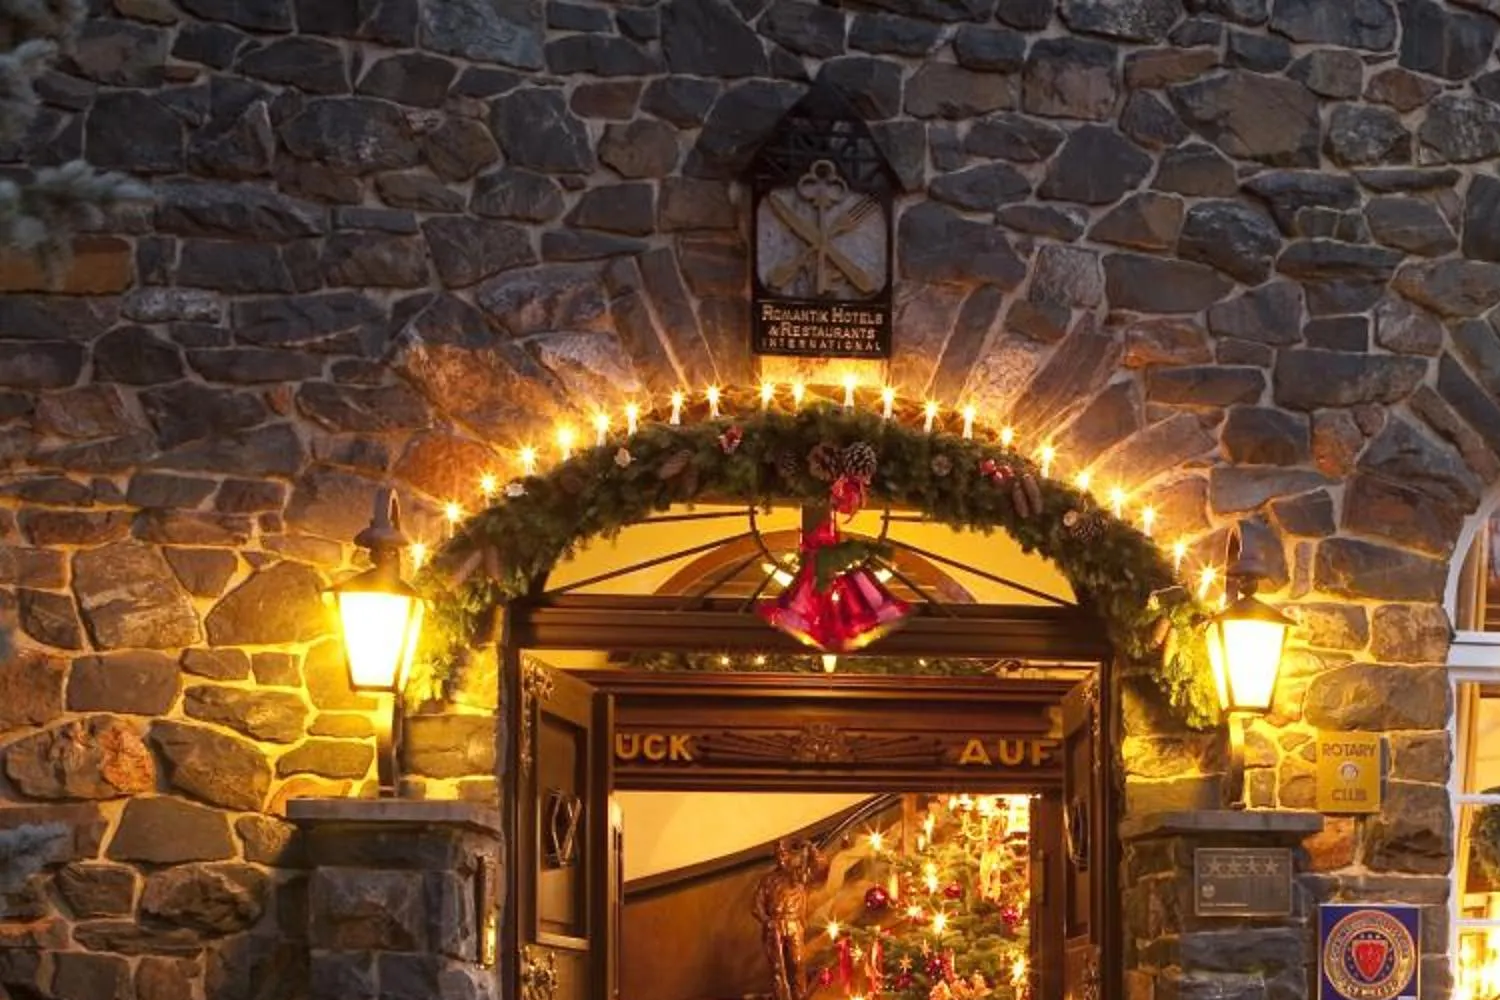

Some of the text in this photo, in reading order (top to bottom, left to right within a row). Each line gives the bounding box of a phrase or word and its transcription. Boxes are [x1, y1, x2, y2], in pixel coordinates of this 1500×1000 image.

[761, 304, 883, 325] ROMANTIK HOTELS
[780, 321, 875, 339] RESTAURANTS
[960, 738, 1058, 767] AUF
